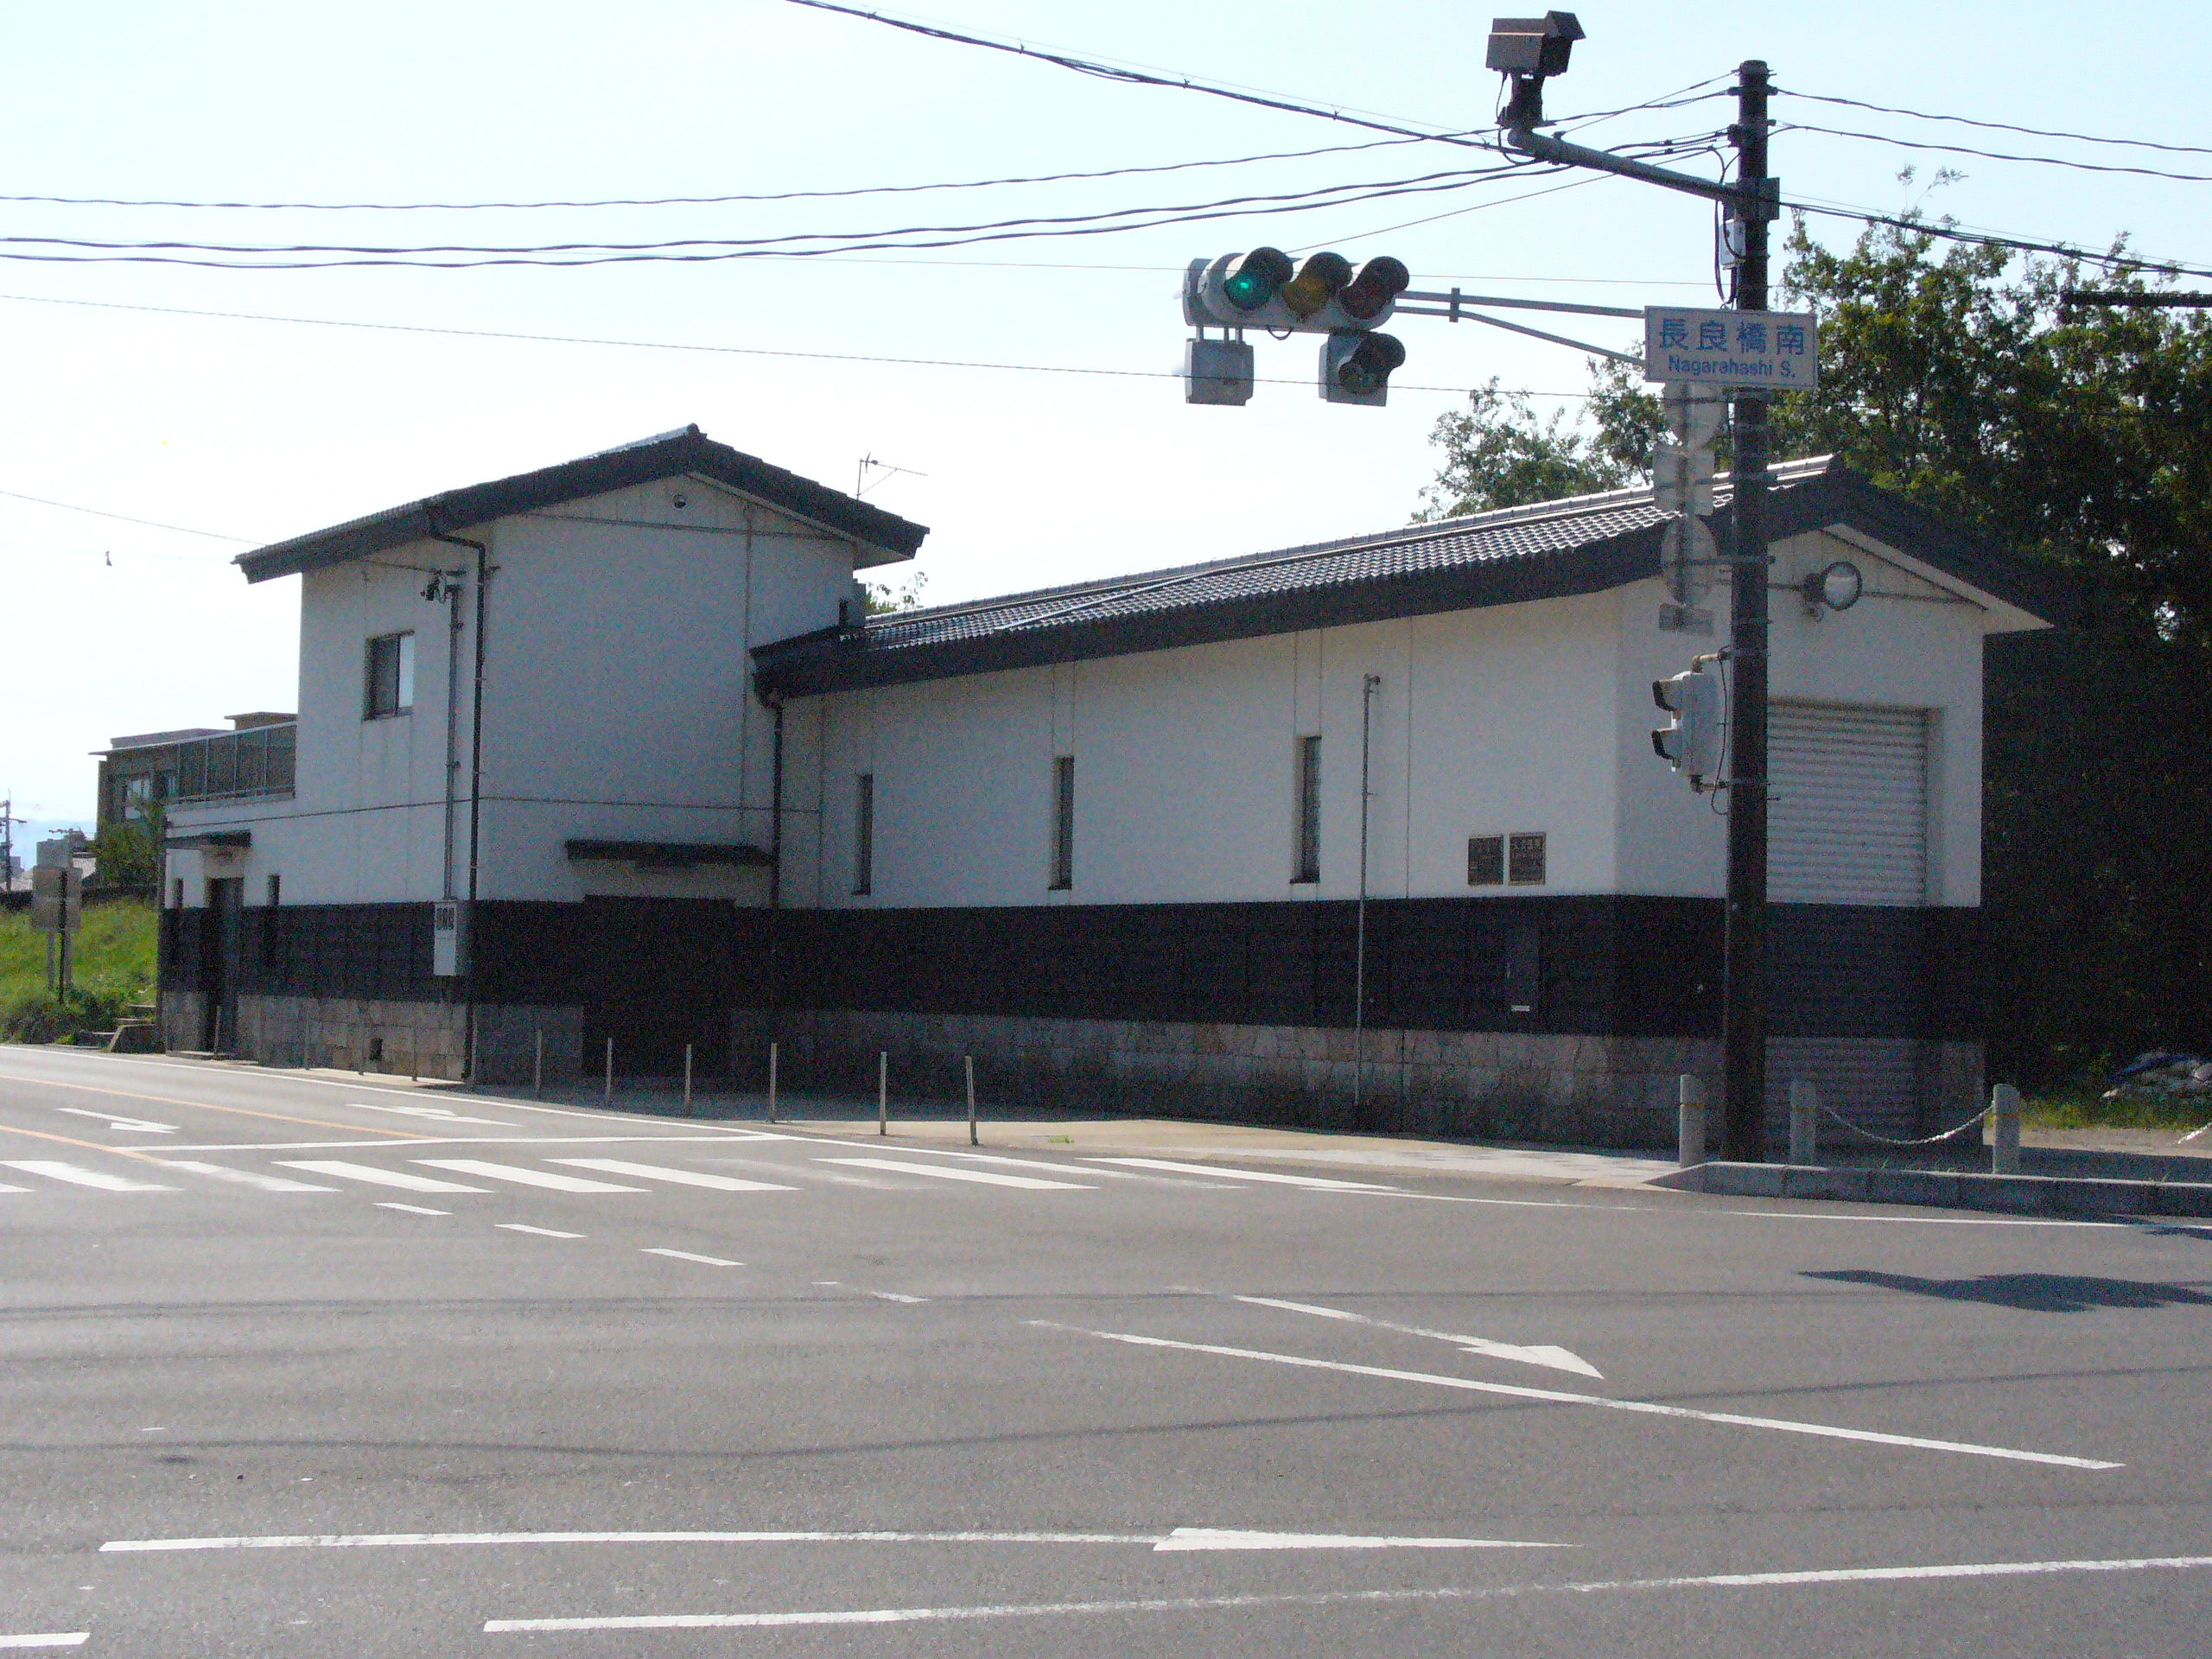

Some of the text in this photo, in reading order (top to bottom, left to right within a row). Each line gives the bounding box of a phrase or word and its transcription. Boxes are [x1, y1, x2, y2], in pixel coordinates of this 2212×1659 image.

[1659, 318, 1804, 355] 長良橋南
[1668, 354, 1796, 378] Nagarahashi S.
